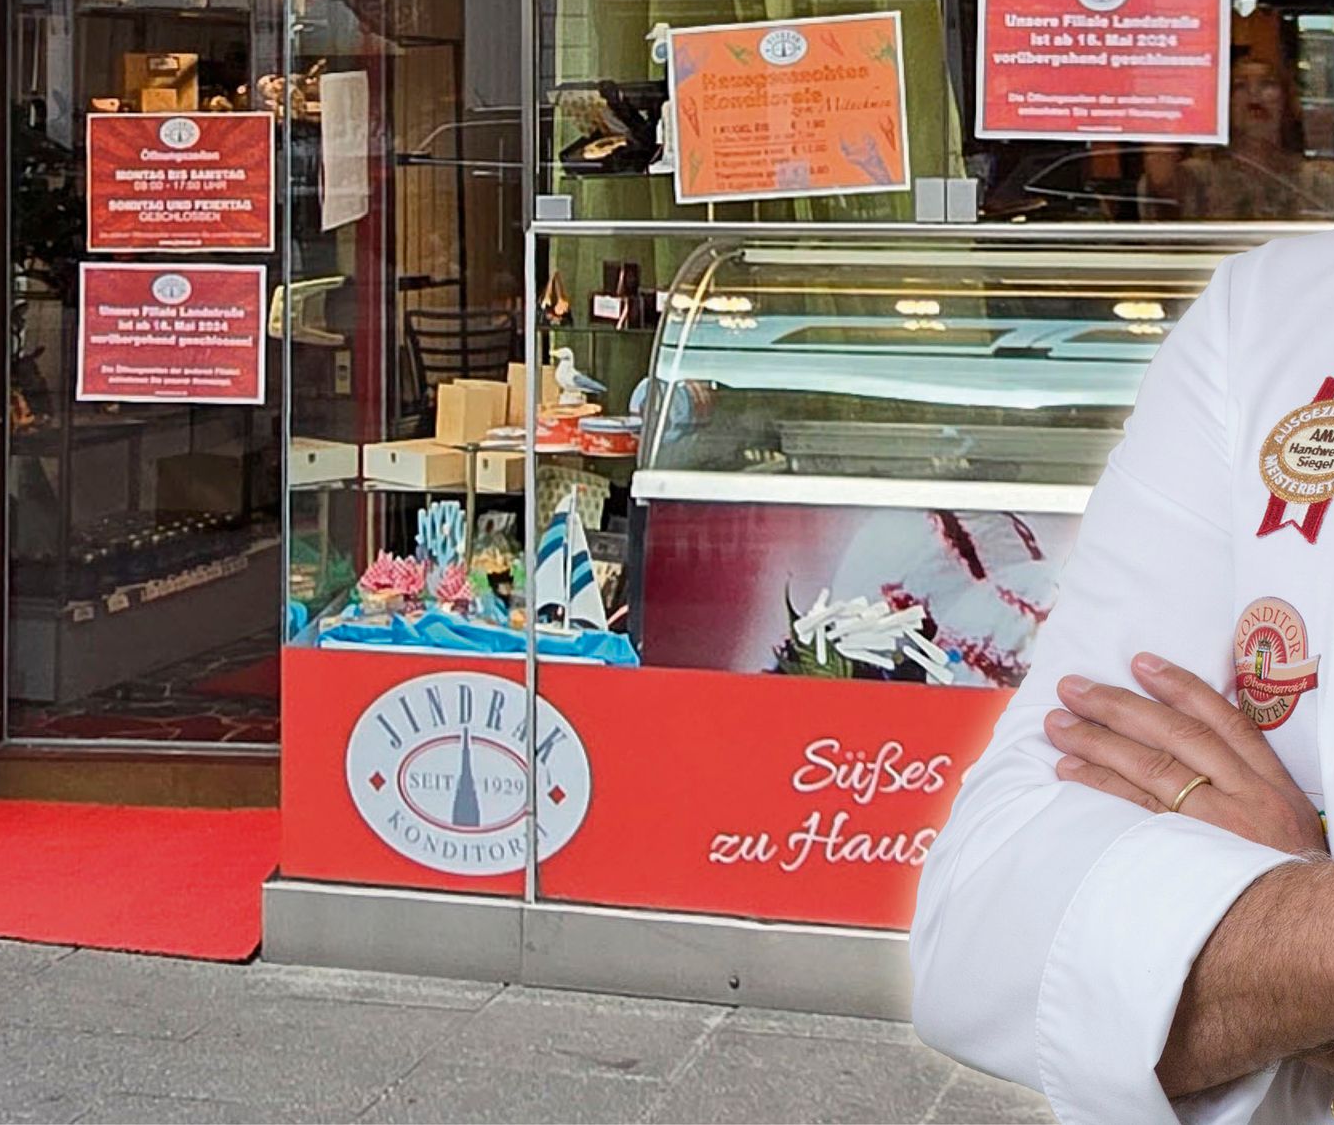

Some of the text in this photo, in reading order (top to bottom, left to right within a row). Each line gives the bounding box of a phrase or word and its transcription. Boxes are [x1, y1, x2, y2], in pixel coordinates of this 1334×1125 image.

[1296, 455, 1334, 471] Siegel
[1236, 606, 1301, 659] KONDITOR
[376, 683, 568, 765] JINDRAK
[408, 772, 525, 795] SEIT 1929
[792, 738, 951, 803] Süßes
[387, 810, 548, 863] KONDITORI
[708, 810, 939, 872] zu Haus
